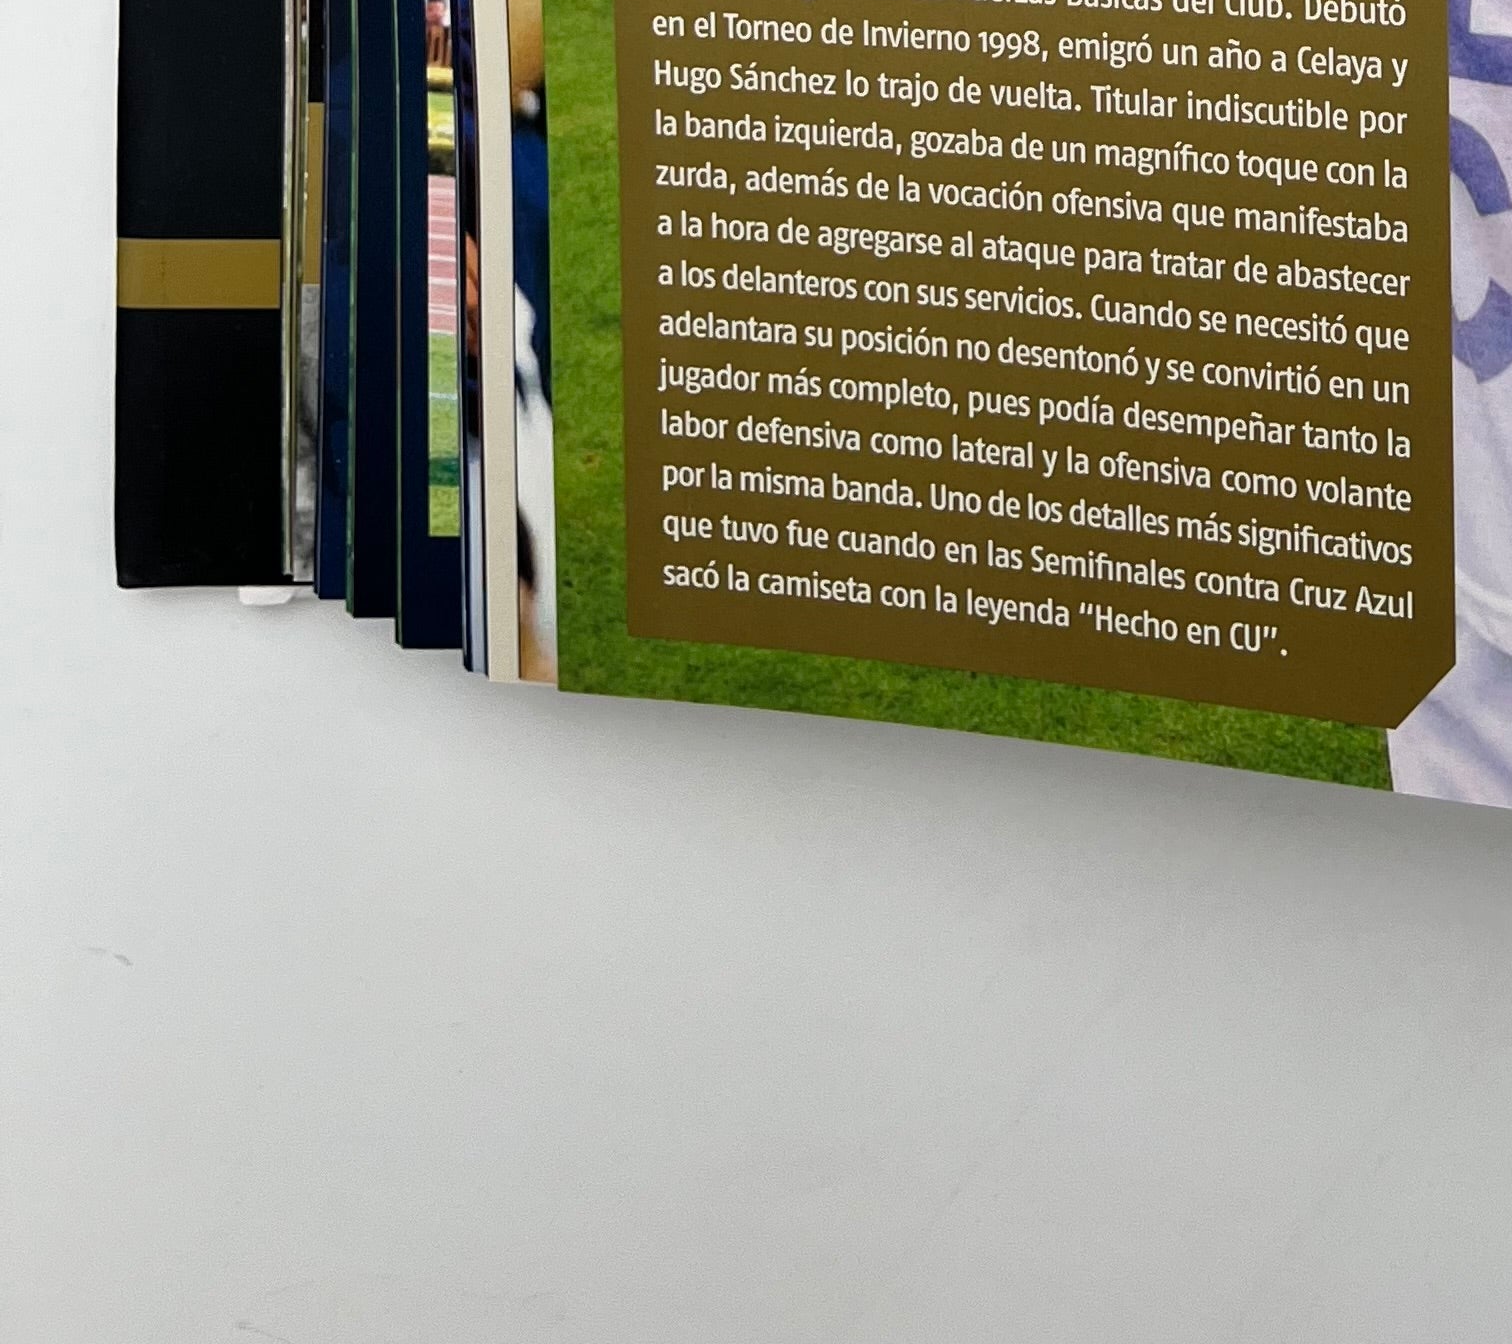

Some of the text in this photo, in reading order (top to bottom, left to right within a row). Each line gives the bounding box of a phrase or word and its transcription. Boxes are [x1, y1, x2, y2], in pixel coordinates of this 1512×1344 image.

[652, 11, 1409, 88] en el Torneo de Invierno 1998, emigró un año a Celaya y
[654, 59, 1408, 139] Hugo Sánchez lo trajo de vuelta. Titular indiscutible por
[655, 108, 1408, 189] la banda izquierda, gozaba de un magnífico toque con la
[655, 161, 1408, 243] zurda, además de la vocación ofensiva que manifestaba
[658, 259, 1410, 355] a los delanteros con sus servicios. Cuando se necesitó que
[657, 357, 1410, 458] jugador más completo, pues podía desempeñar tanto la
[663, 462, 1412, 566] por la misma banda. Uno de los detalles más significativos
[663, 514, 1413, 620] que tuvo fue cuando en las Semifinales contra Cruz Azul
[663, 560, 720, 589] sacó
[728, 563, 750, 592] la
[758, 570, 872, 604] camiseta
[880, 585, 926, 610] con
[935, 584, 958, 614] la
[967, 588, 1070, 627] leyenda
[1186, 622, 1220, 647] en
